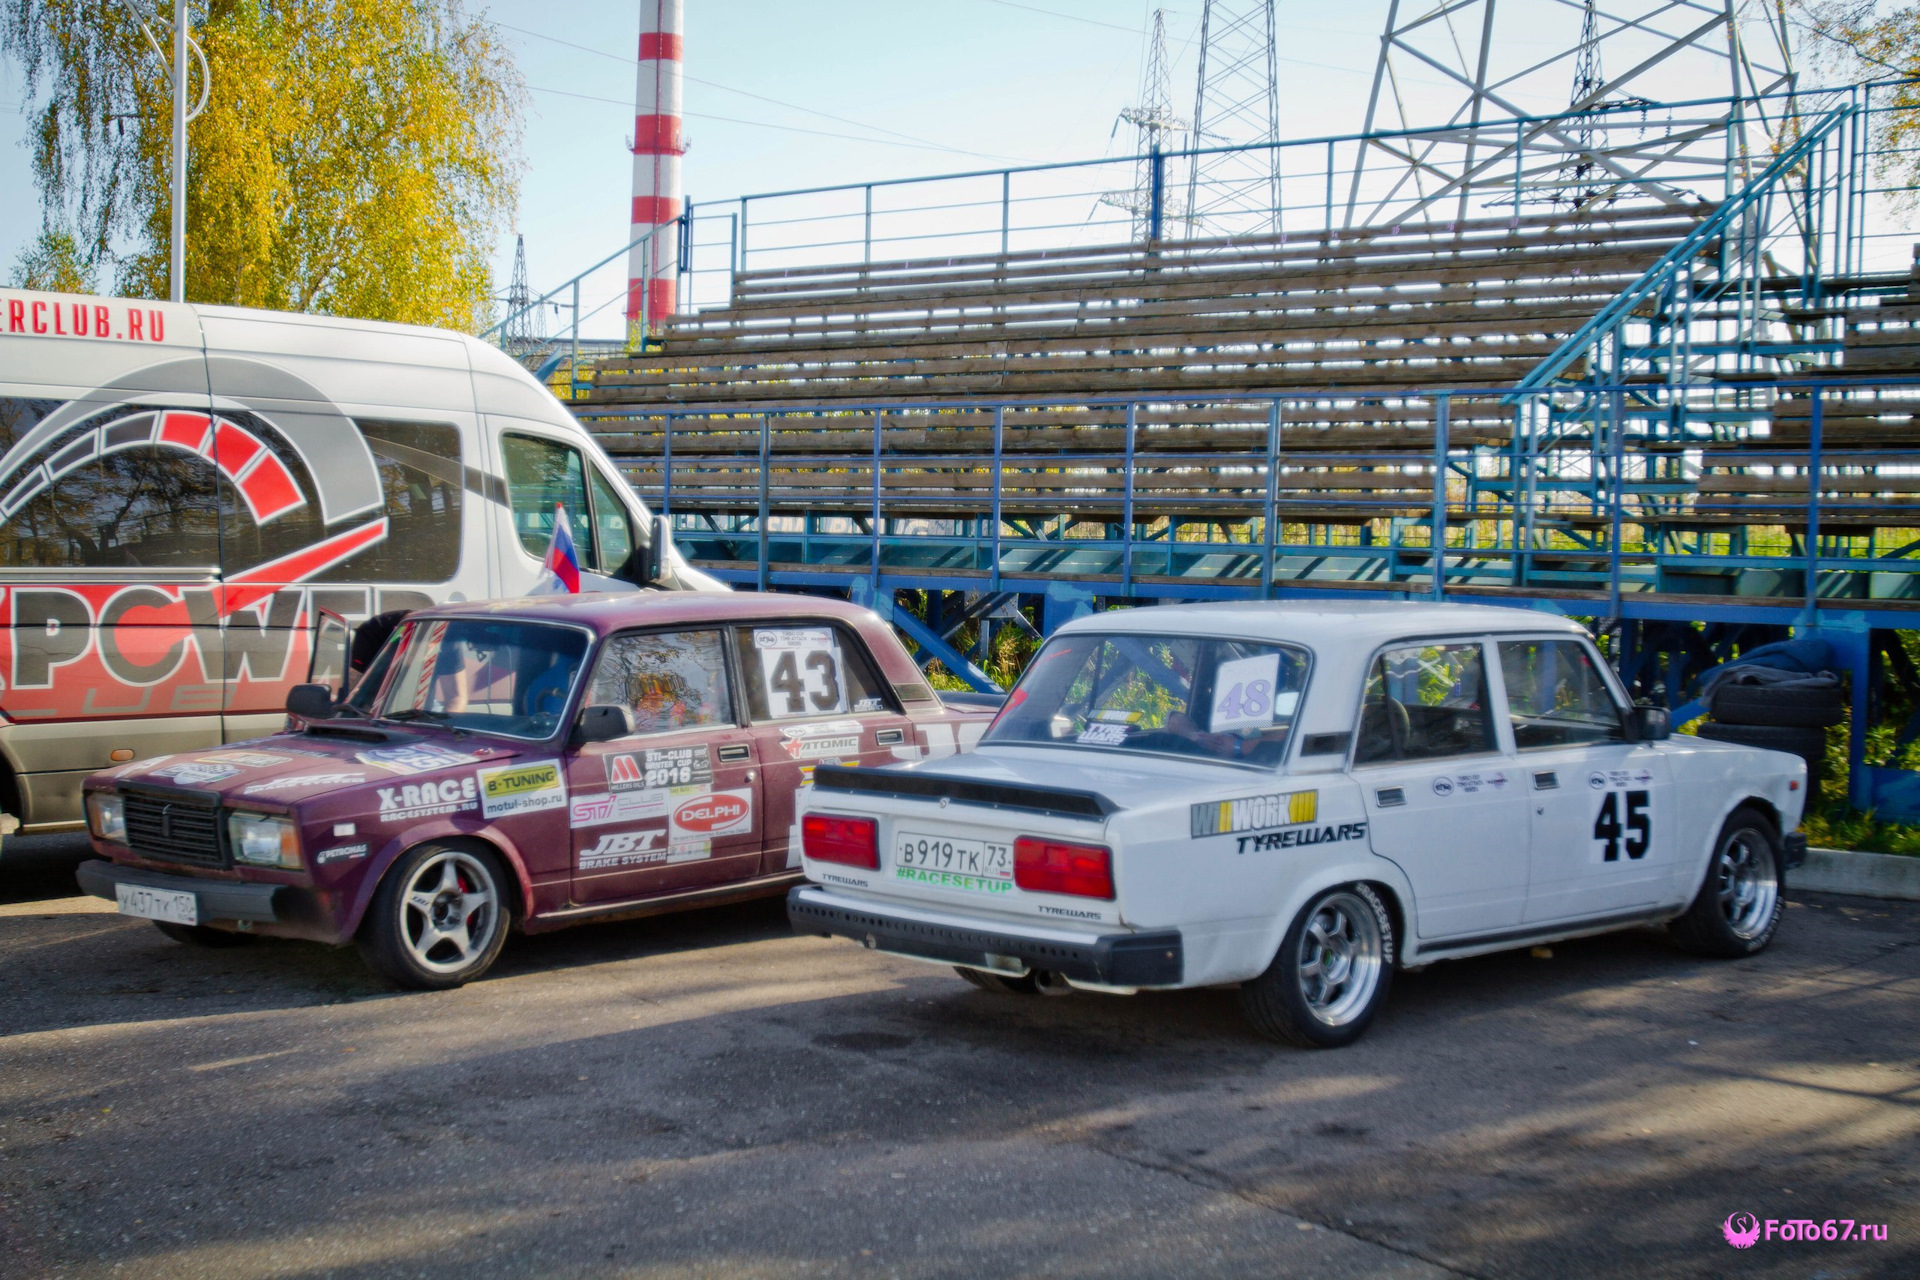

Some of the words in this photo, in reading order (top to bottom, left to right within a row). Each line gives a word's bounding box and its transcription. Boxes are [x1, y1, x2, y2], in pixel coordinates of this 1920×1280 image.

[0, 299, 164, 342] RCLUB.RU
[770, 650, 840, 713] 43
[1217, 679, 1271, 720] 48
[801, 738, 857, 750] ATOMIC
[645, 761, 674, 770] WINTER
[677, 759, 692, 767] CUP
[645, 766, 692, 787] 2016
[376, 777, 477, 811] X-RACE
[487, 795, 562, 814] motul-shop.ru
[380, 801, 478, 822] RACESYSTEM.RU
[682, 804, 740, 822] DELPHI
[1594, 790, 1651, 862] 45
[1236, 822, 1368, 854] TYREWARS
[579, 857, 619, 870] BRAKE
[621, 852, 668, 865] SYSTEM
[904, 839, 979, 873] В919ТК
[988, 846, 1007, 867] 73
[821, 873, 869, 888] TYREWARS
[897, 868, 1012, 894] #RACESETUP
[1038, 905, 1102, 920] TYREWARS
